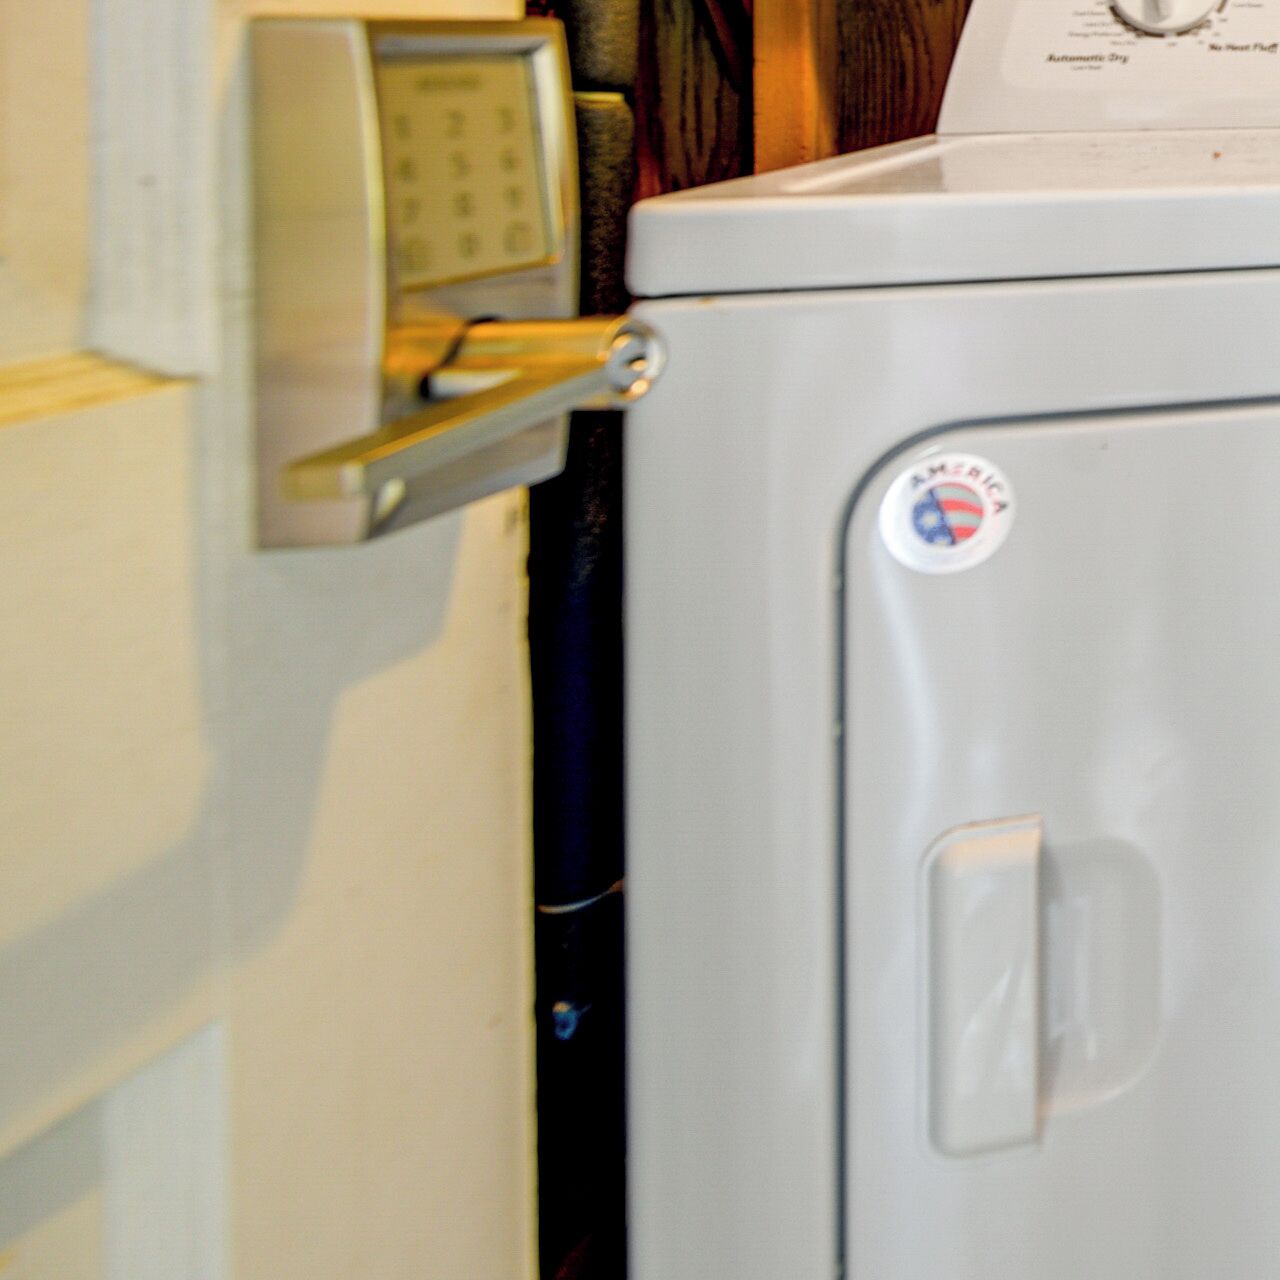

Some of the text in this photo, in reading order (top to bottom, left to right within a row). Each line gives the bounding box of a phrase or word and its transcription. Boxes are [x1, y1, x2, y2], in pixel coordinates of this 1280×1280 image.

[1253, 42, 1280, 54] Fluff
[1047, 53, 1130, 64] Automatic Dry
[910, 463, 1009, 516] AMERICA
